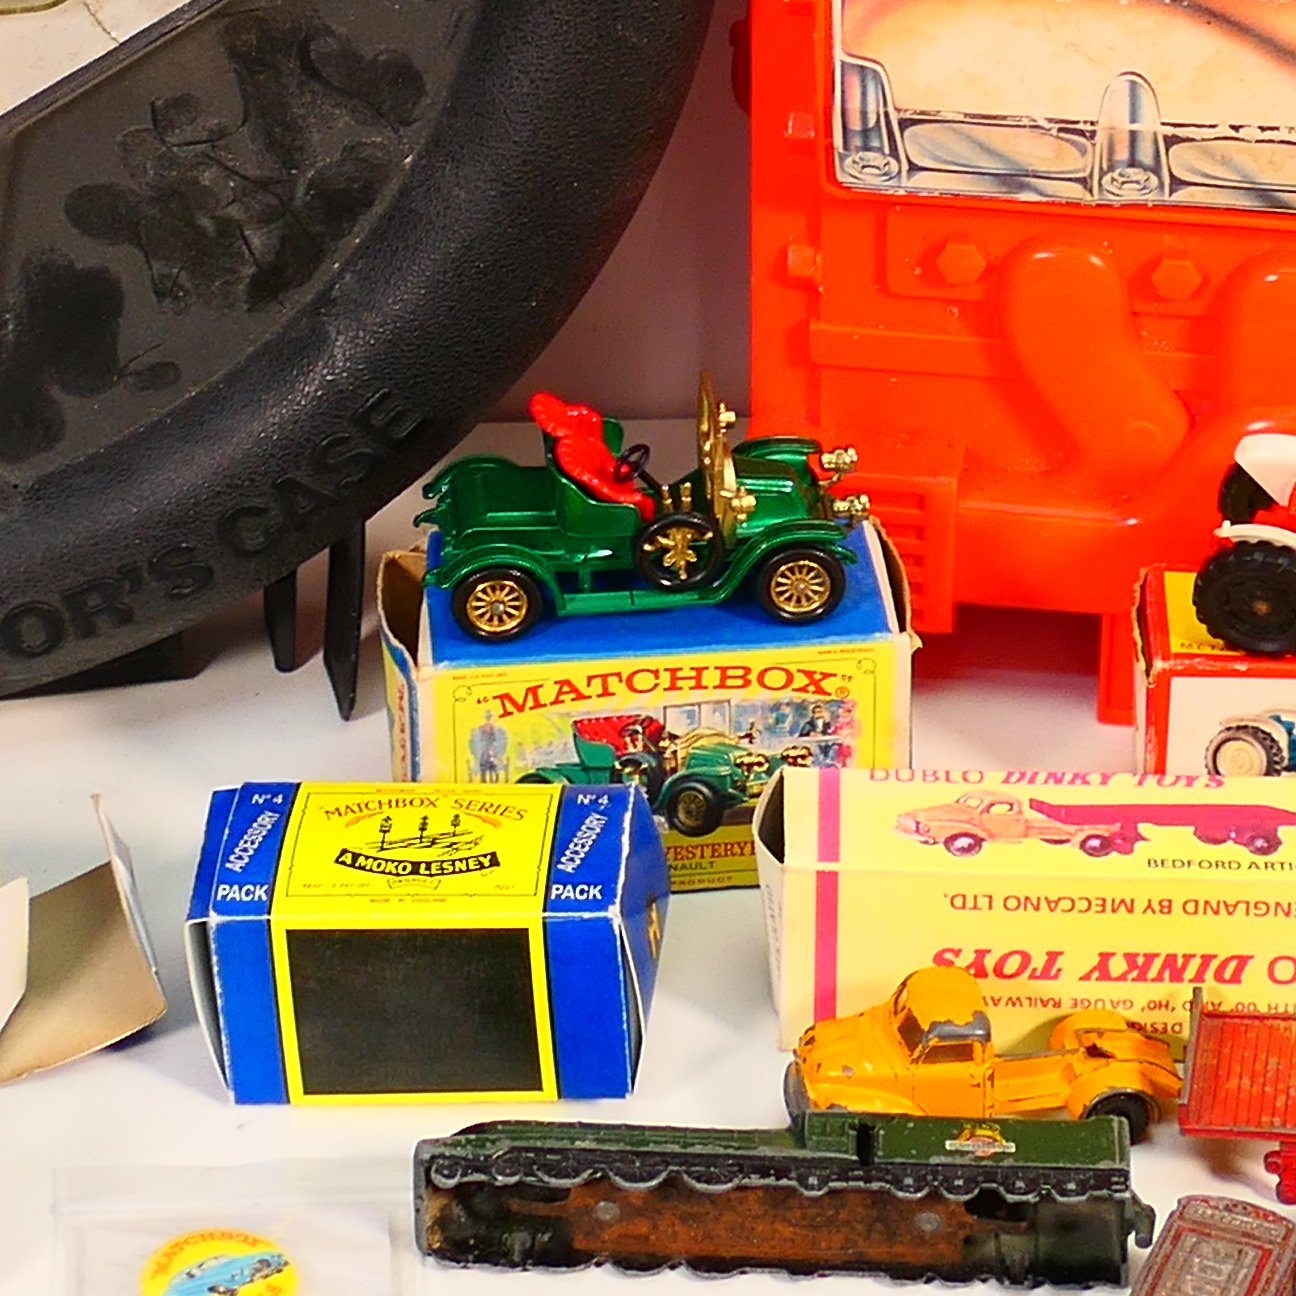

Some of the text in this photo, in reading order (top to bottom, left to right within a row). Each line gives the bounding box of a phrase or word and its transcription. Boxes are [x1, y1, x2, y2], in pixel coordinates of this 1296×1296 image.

[216, 384, 427, 561] CASE
[869, 768, 1226, 789] DUBLO DINKY TOYS
[451, 797, 529, 821] SERIES
[224, 810, 281, 874] ACCESSORY
[556, 812, 609, 874] ACCESSORY
[338, 852, 492, 875] A MOKO LESNEY
[1146, 857, 1242, 872] BEDFORD
[217, 883, 269, 902] PACK
[550, 883, 603, 901] PACK
[944, 891, 994, 912] LTD.
[1004, 894, 1136, 916] MECCANO
[1142, 897, 1176, 916] BY
[932, 946, 1065, 982] TOYS
[1079, 950, 1256, 986] DINKY
[1067, 996, 1135, 1011] GAUGE
